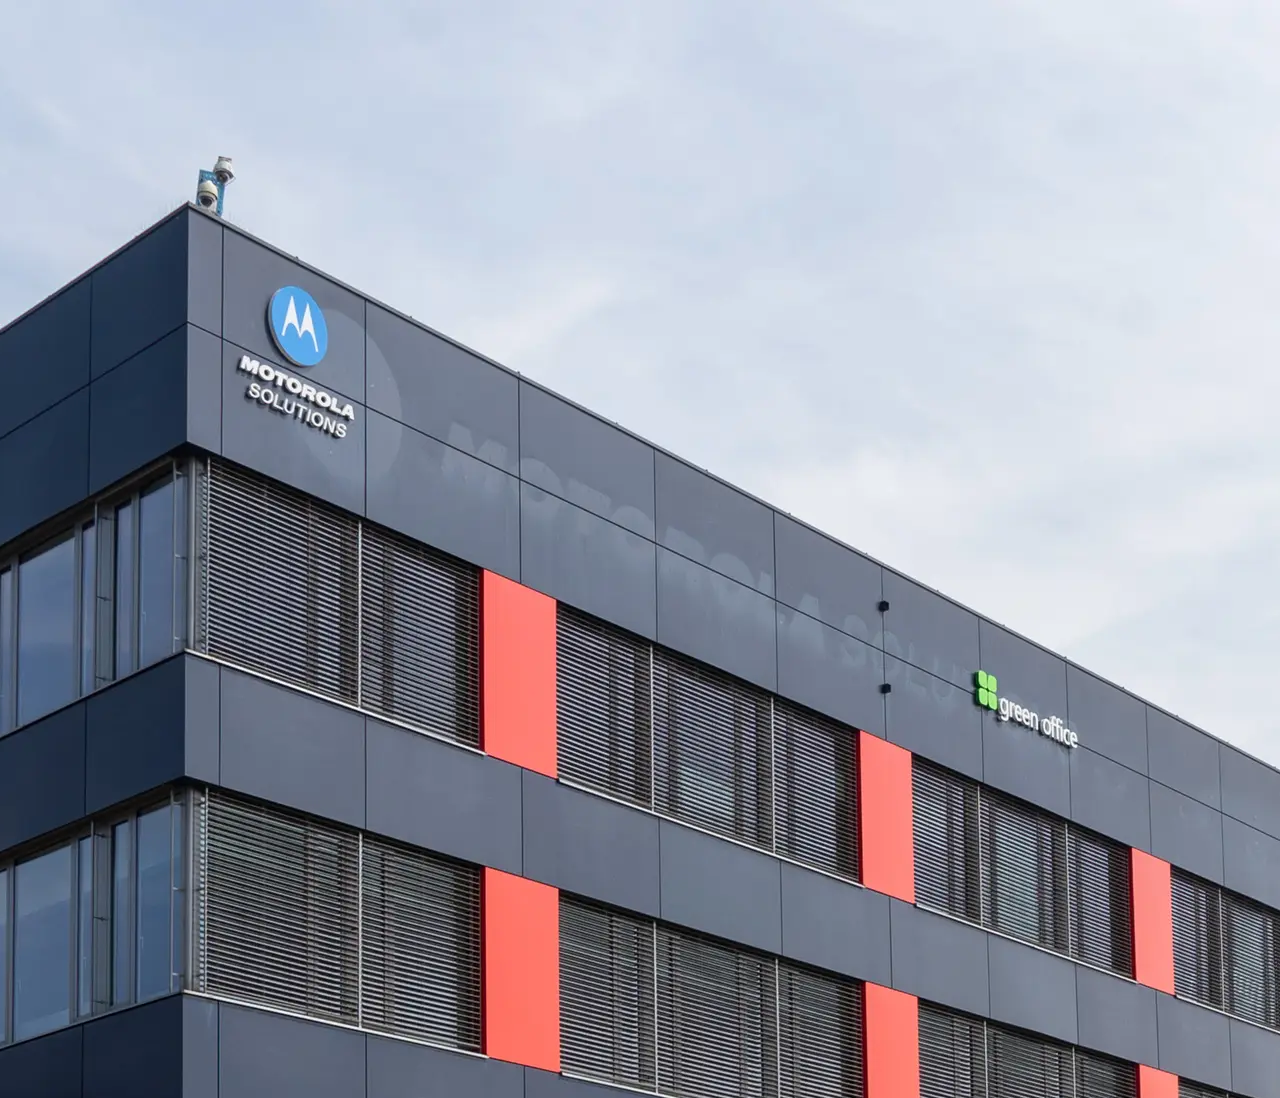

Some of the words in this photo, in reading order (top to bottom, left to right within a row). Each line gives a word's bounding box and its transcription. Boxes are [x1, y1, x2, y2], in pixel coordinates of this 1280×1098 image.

[239, 355, 355, 420] MOTOROLA
[247, 382, 347, 439] SOLUTIONS
[998, 697, 1039, 731] green
[1040, 715, 1078, 748] office
